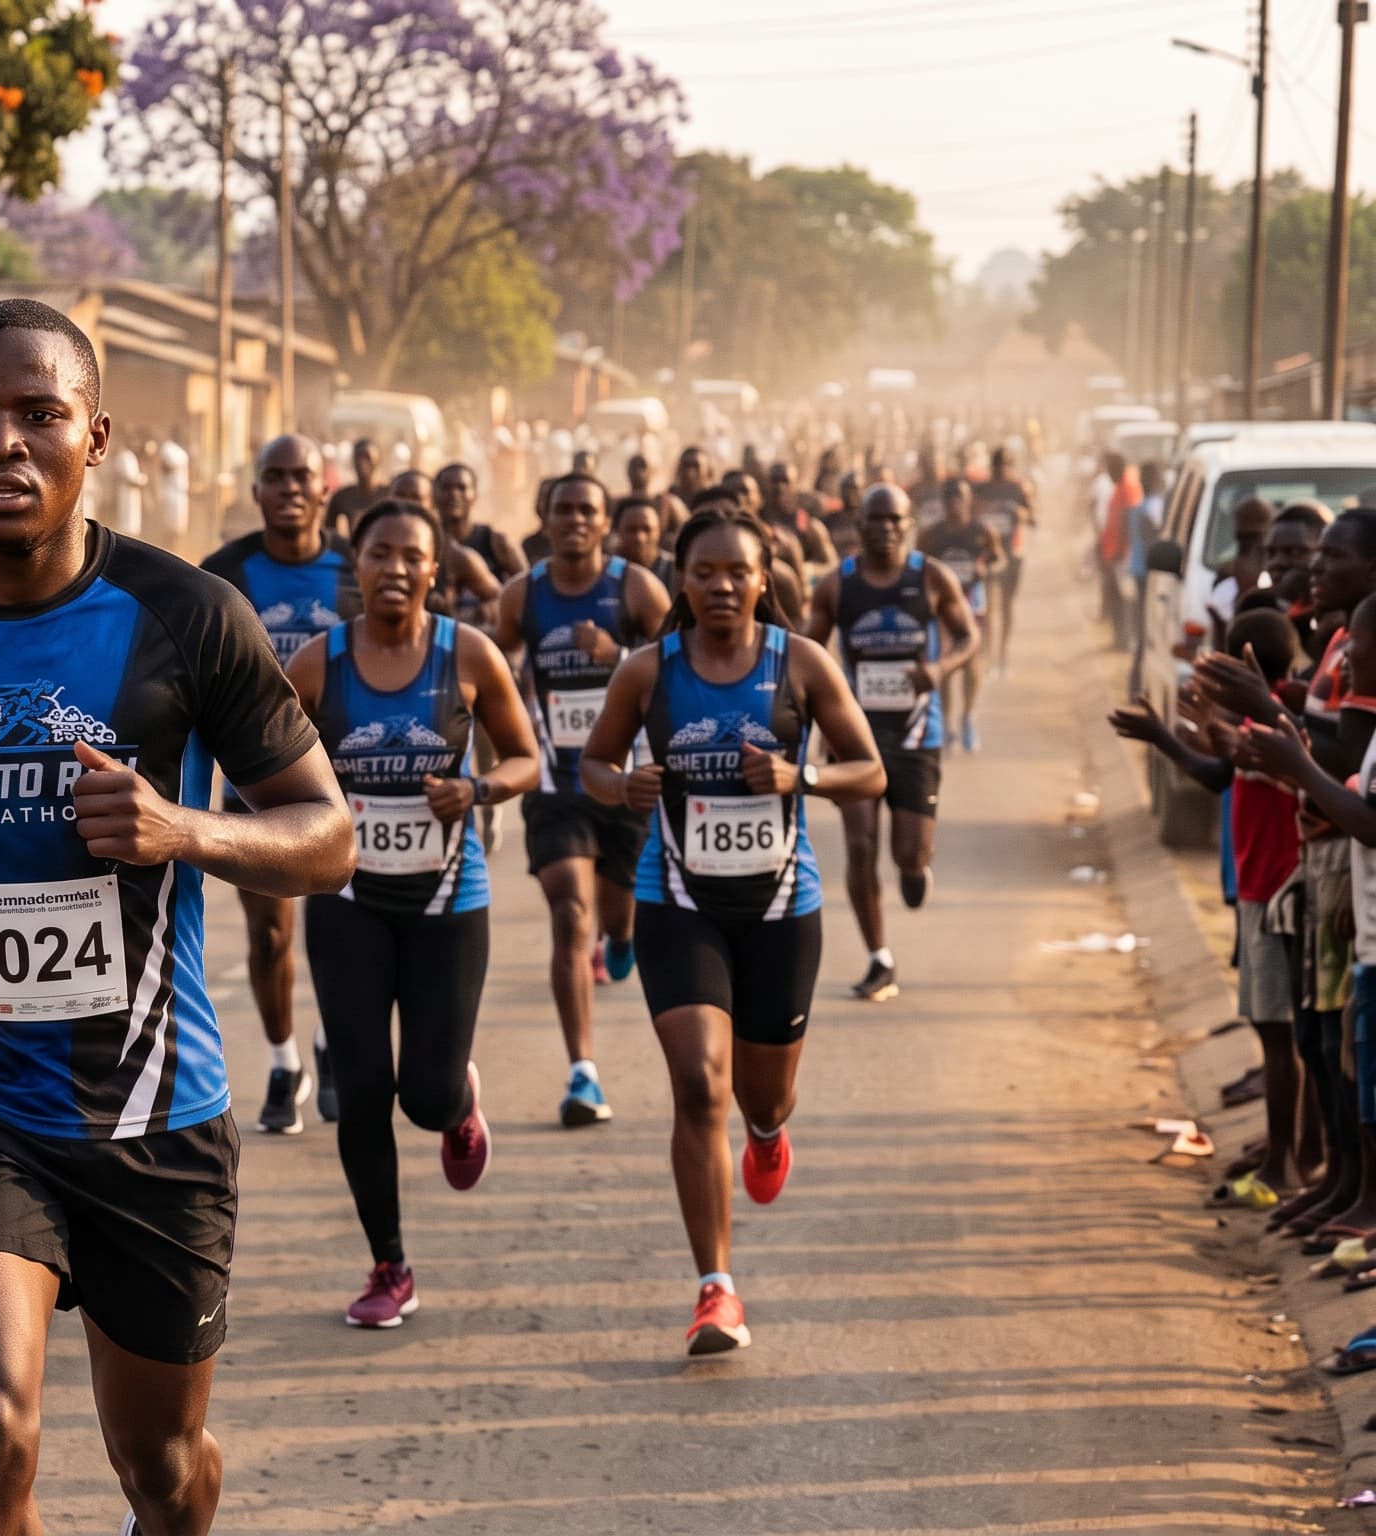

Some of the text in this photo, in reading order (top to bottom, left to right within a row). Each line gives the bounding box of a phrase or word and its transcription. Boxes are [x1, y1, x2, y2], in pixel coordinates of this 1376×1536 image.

[557, 708, 596, 730] 168
[332, 753, 455, 774] GHETTO RUN
[666, 752, 740, 771] GHETTO
[355, 820, 432, 851] 1857
[695, 820, 774, 852] 1856
